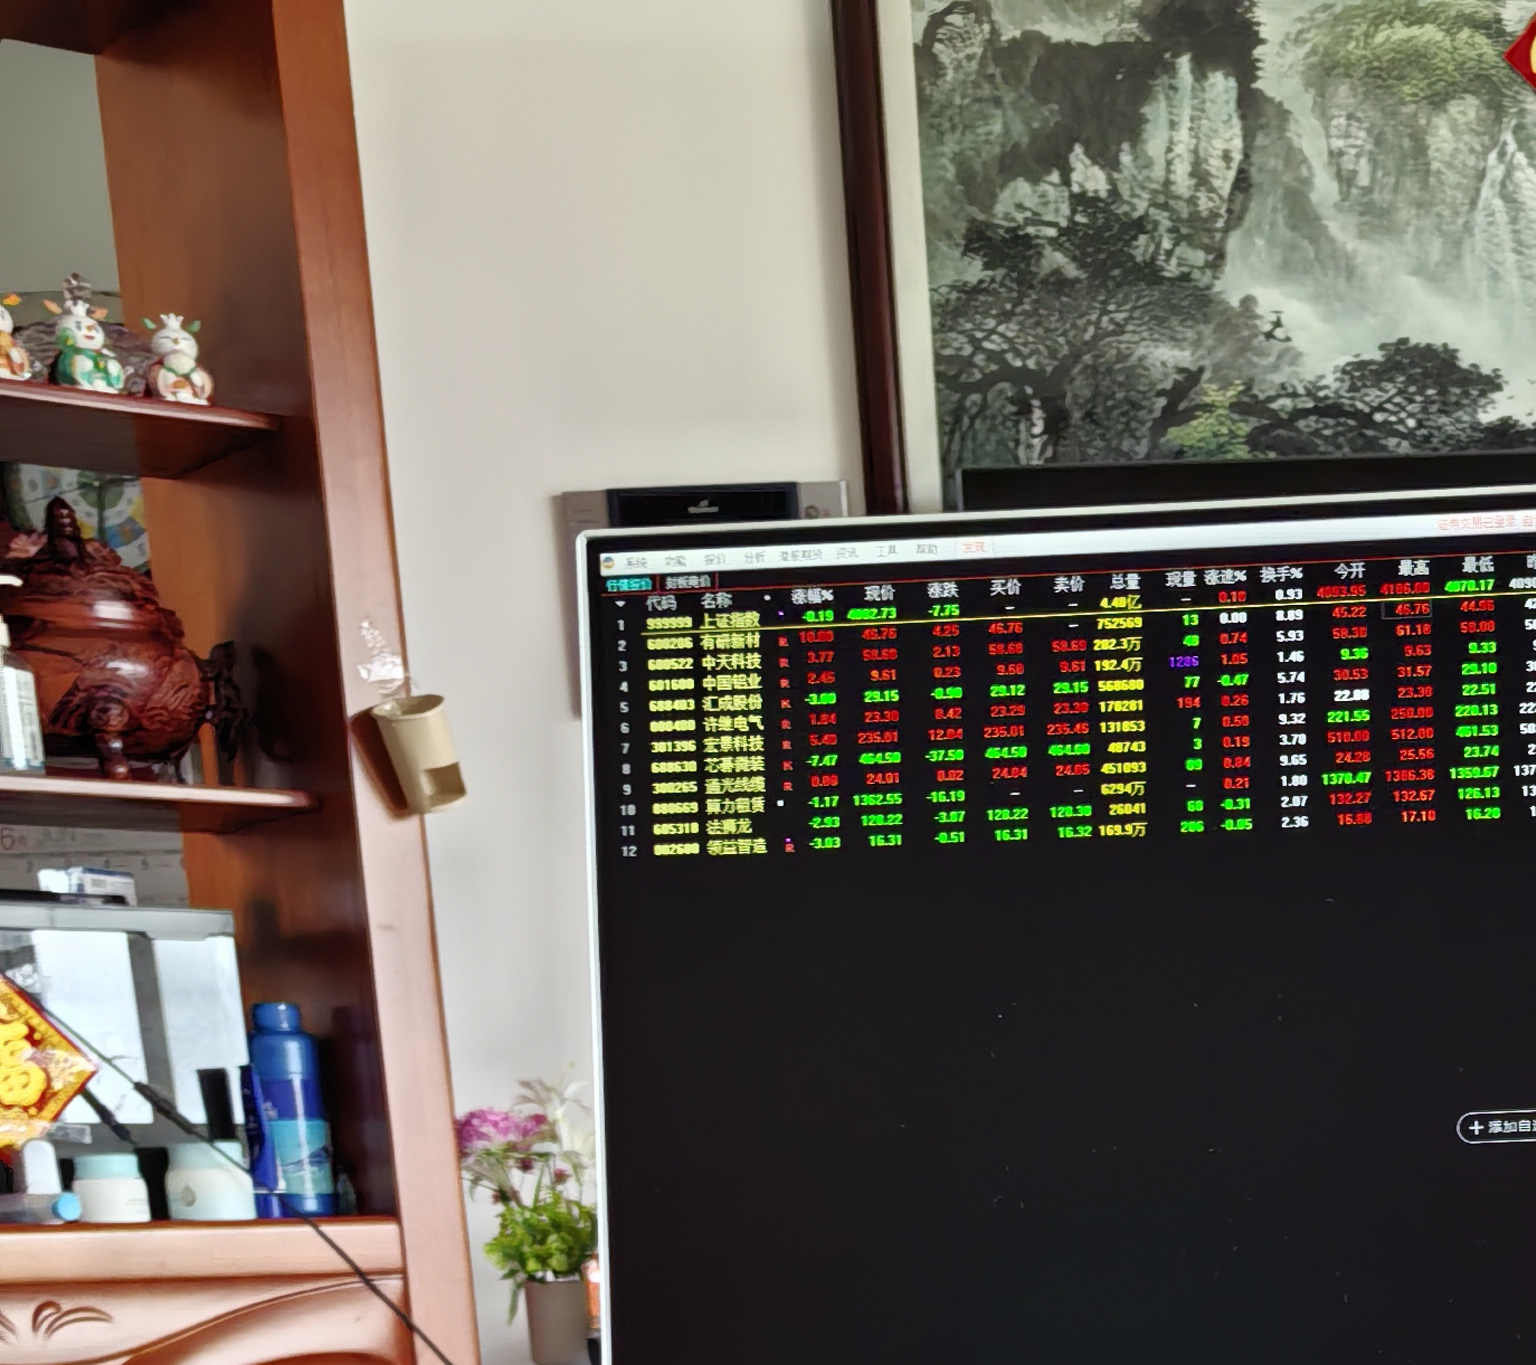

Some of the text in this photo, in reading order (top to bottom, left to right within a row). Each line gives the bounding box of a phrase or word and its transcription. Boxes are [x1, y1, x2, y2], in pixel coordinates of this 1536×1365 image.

[647, 596, 676, 611] 代码
[701, 593, 732, 608] 名称
[864, 586, 895, 601] 现价
[928, 583, 959, 598] 涨跌
[991, 579, 1021, 595] 买价
[1054, 576, 1084, 593] 卖价
[1110, 574, 1140, 590] 总量
[1166, 569, 1196, 587] 现量
[1260, 564, 1303, 583] 换手%
[1335, 562, 1365, 579] 今开
[1398, 558, 1430, 576] 最高
[1462, 557, 1494, 573] 最低
[617, 620, 625, 631] 1
[700, 612, 760, 628] 上证指数
[928, 604, 960, 617] -7.75
[618, 640, 626, 651] 2
[1182, 613, 1199, 626] 13
[619, 661, 627, 671] 3
[702, 653, 761, 670] 中天科技
[808, 651, 834, 663] 3.77
[1276, 630, 1304, 642] 5.93
[620, 682, 628, 692] 4
[703, 673, 762, 691] 中国铝业
[620, 702, 628, 712] 5
[702, 694, 762, 711] 汇成股份
[864, 689, 899, 702] 29.15
[1185, 676, 1200, 688] 77
[1277, 671, 1305, 683] 5.74
[1398, 665, 1432, 677] 31.57
[621, 722, 629, 733] 6
[703, 715, 764, 732] 许继电气
[1177, 697, 1200, 708] 194
[622, 743, 629, 753] 7
[703, 735, 764, 752] 宏景科技
[1193, 717, 1201, 729] 7
[1279, 713, 1306, 725] 9.32
[1327, 709, 1370, 723] 221.55
[623, 764, 630, 774] 8
[807, 754, 838, 766] -7.47
[1194, 738, 1202, 750] 3
[621, 805, 636, 815] 10
[808, 795, 839, 808] -1.17
[623, 784, 631, 795] 9
[622, 825, 634, 836] 11
[809, 816, 841, 829] -2.93
[1393, 789, 1436, 802] 132.67
[622, 846, 637, 856] 12
[869, 834, 902, 847] 16.31
[1402, 809, 1436, 822] 17.10
